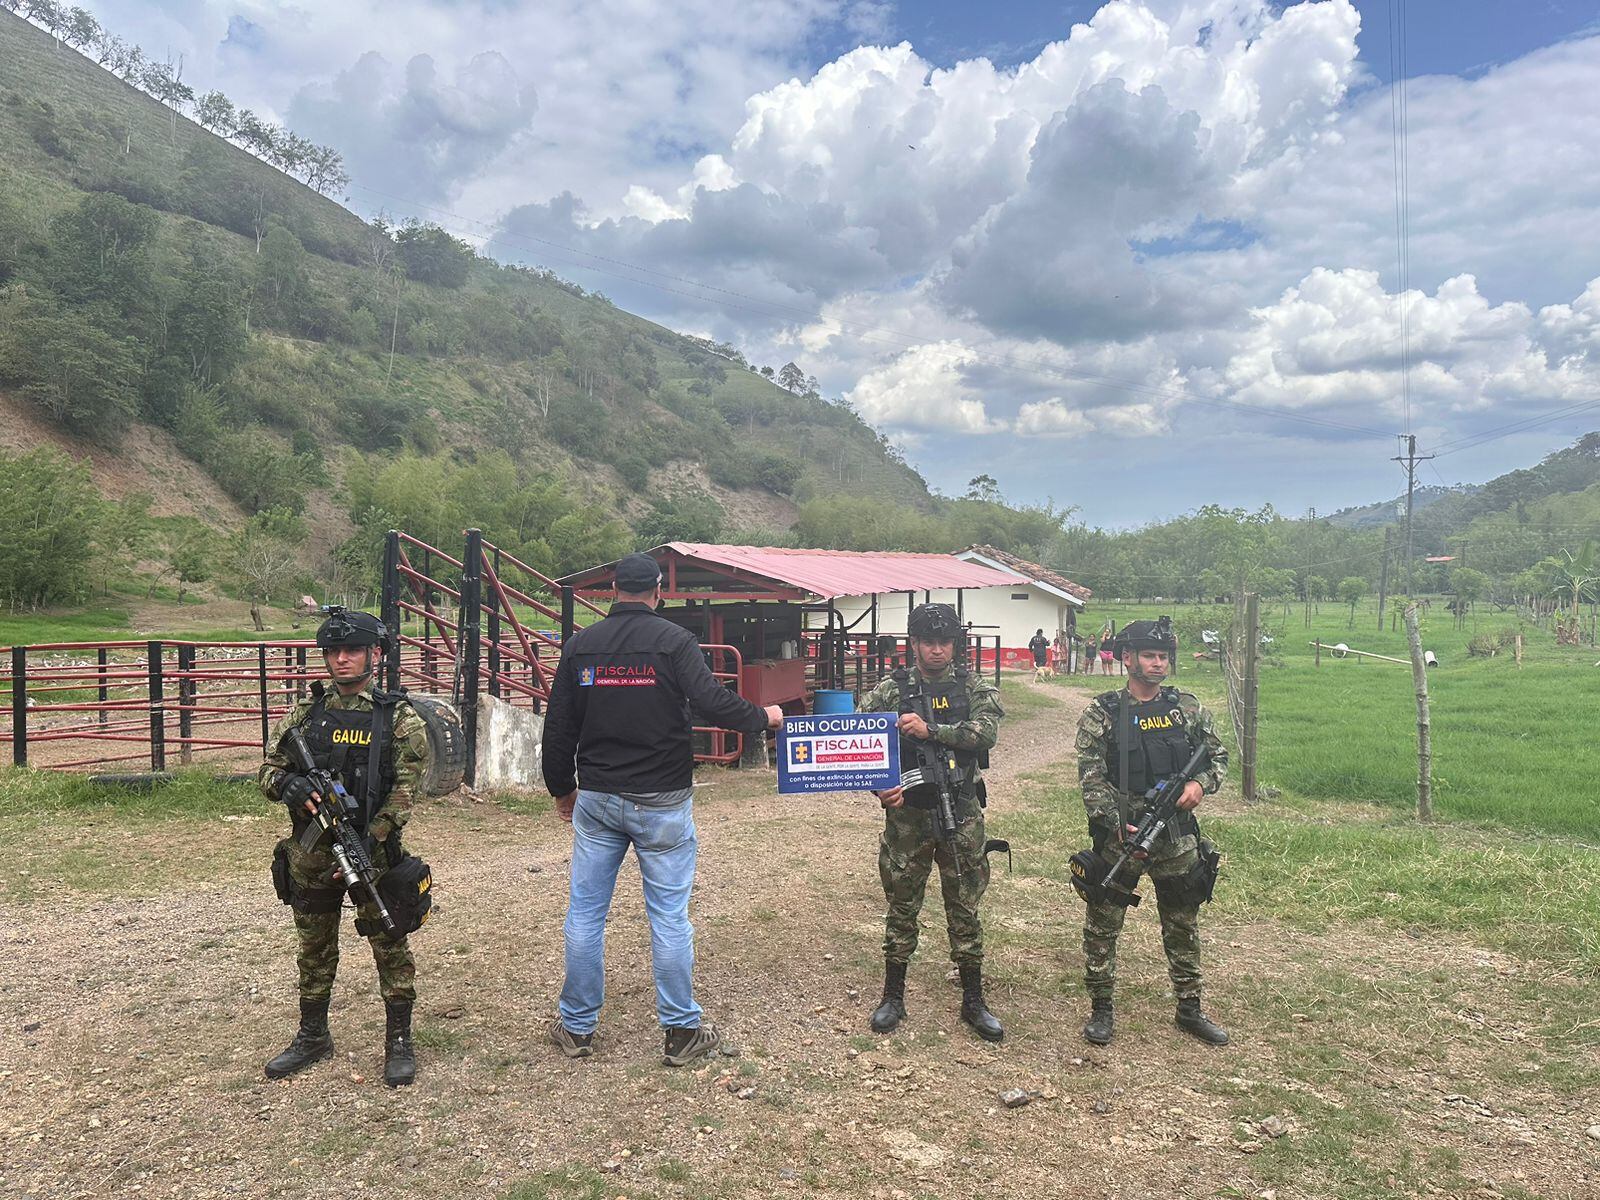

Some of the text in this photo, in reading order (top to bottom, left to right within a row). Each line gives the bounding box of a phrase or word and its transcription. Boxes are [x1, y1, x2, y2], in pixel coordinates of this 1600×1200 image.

[596, 664, 656, 676] FISCALÍA
[786, 717, 888, 734] BIEN OCUPADO
[1139, 715, 1173, 730] GAULA
[815, 736, 883, 751] FISCALÍA
[817, 754, 844, 762] GENERAL
[810, 781, 843, 789] disposición
